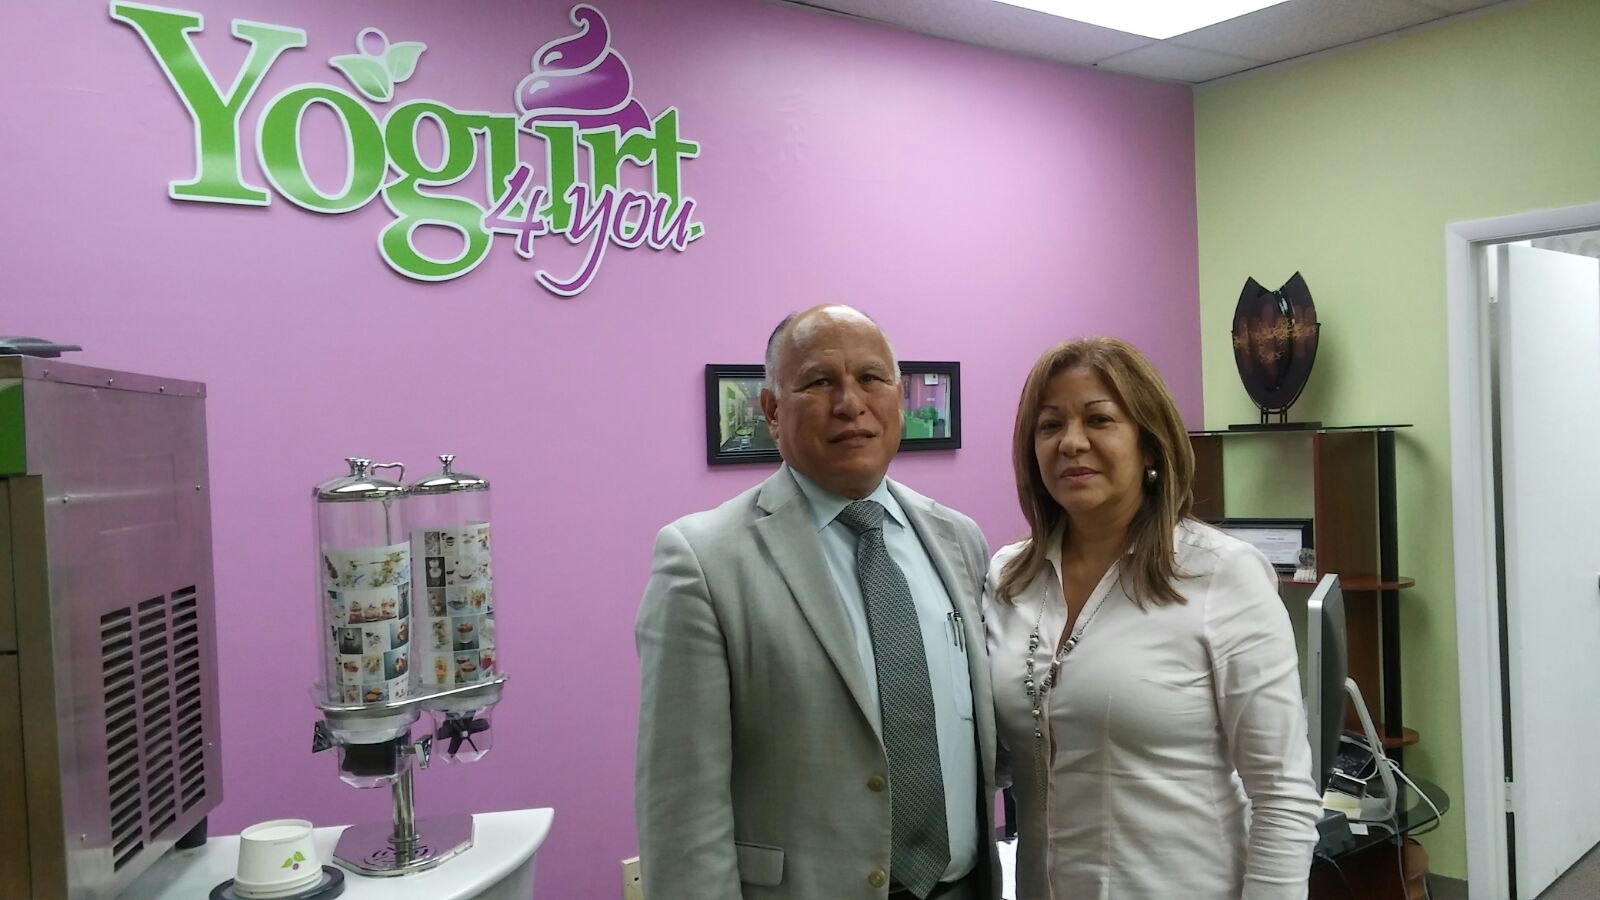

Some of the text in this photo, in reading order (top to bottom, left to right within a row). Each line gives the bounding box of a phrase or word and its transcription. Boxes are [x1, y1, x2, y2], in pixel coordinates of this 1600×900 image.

[110, 2, 700, 281] Yogurt
[485, 163, 695, 297] 4 you
